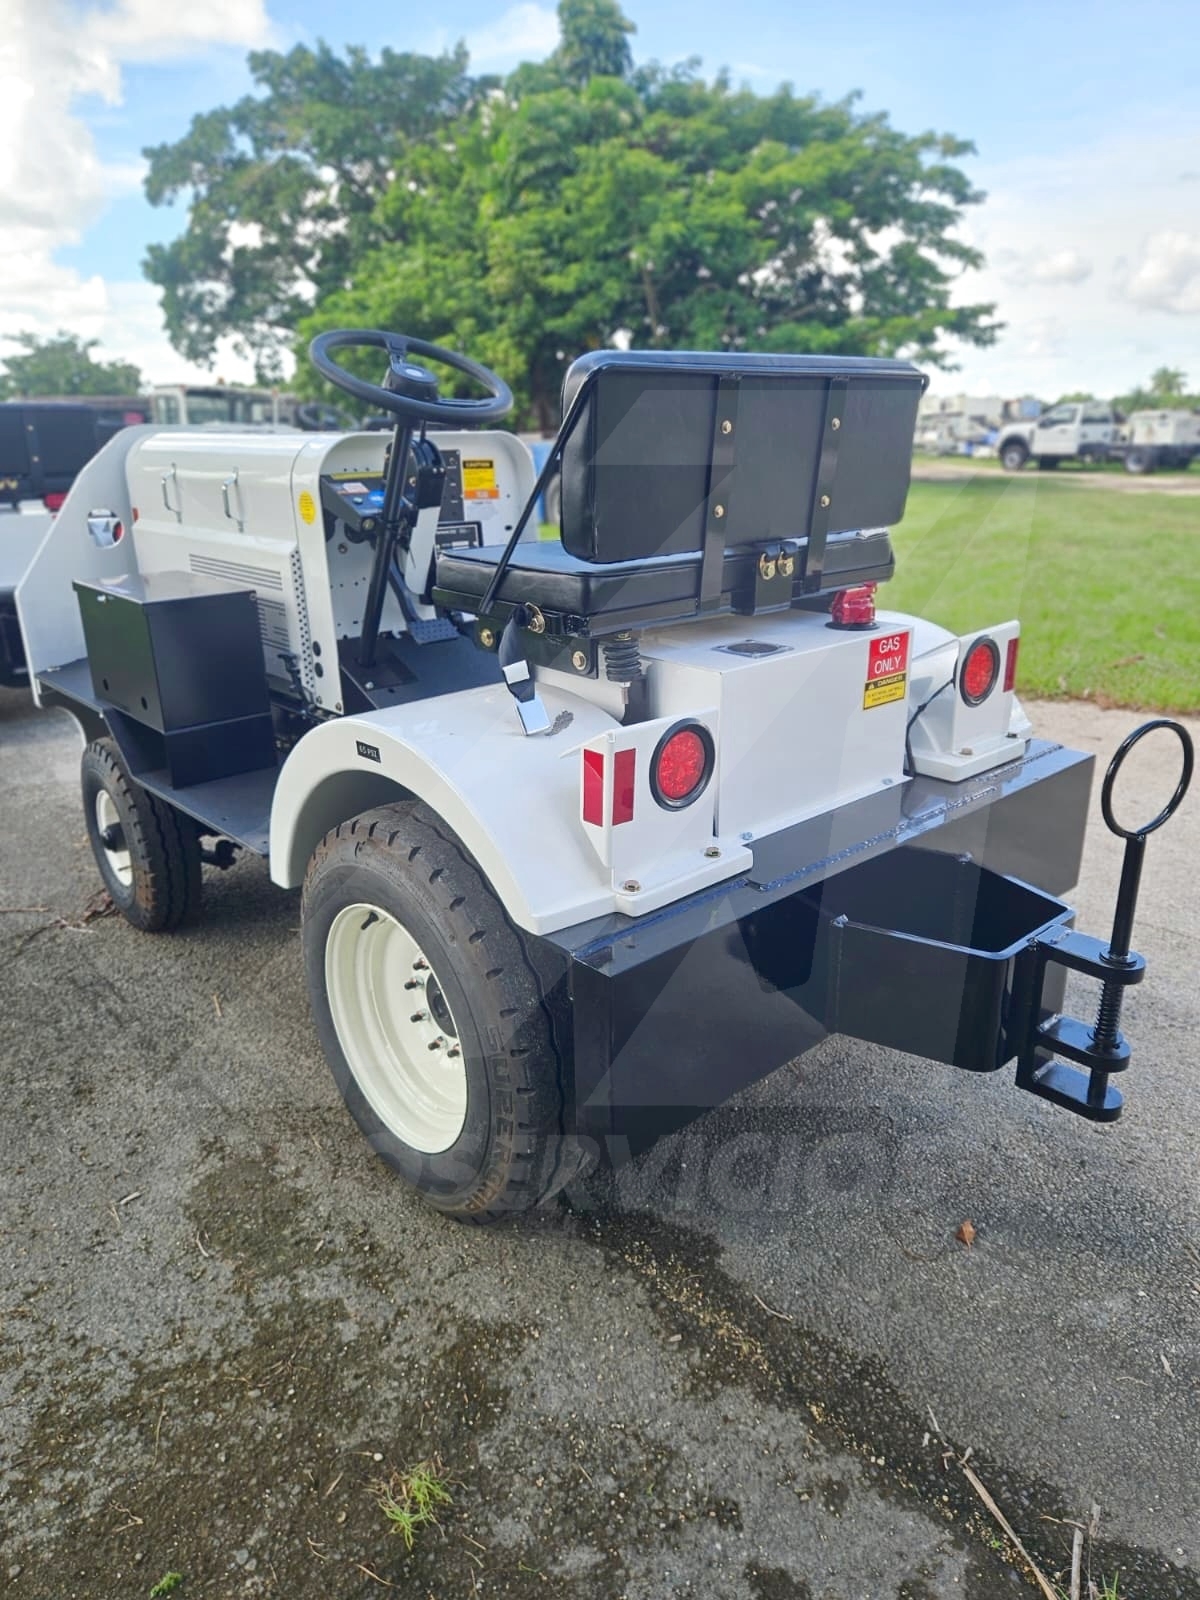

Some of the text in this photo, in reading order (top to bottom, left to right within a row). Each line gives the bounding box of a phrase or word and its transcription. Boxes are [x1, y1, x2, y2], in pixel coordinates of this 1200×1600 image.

[879, 636, 900, 654] GAS
[874, 655, 902, 674] ONLY
[877, 675, 903, 687] DANGER
